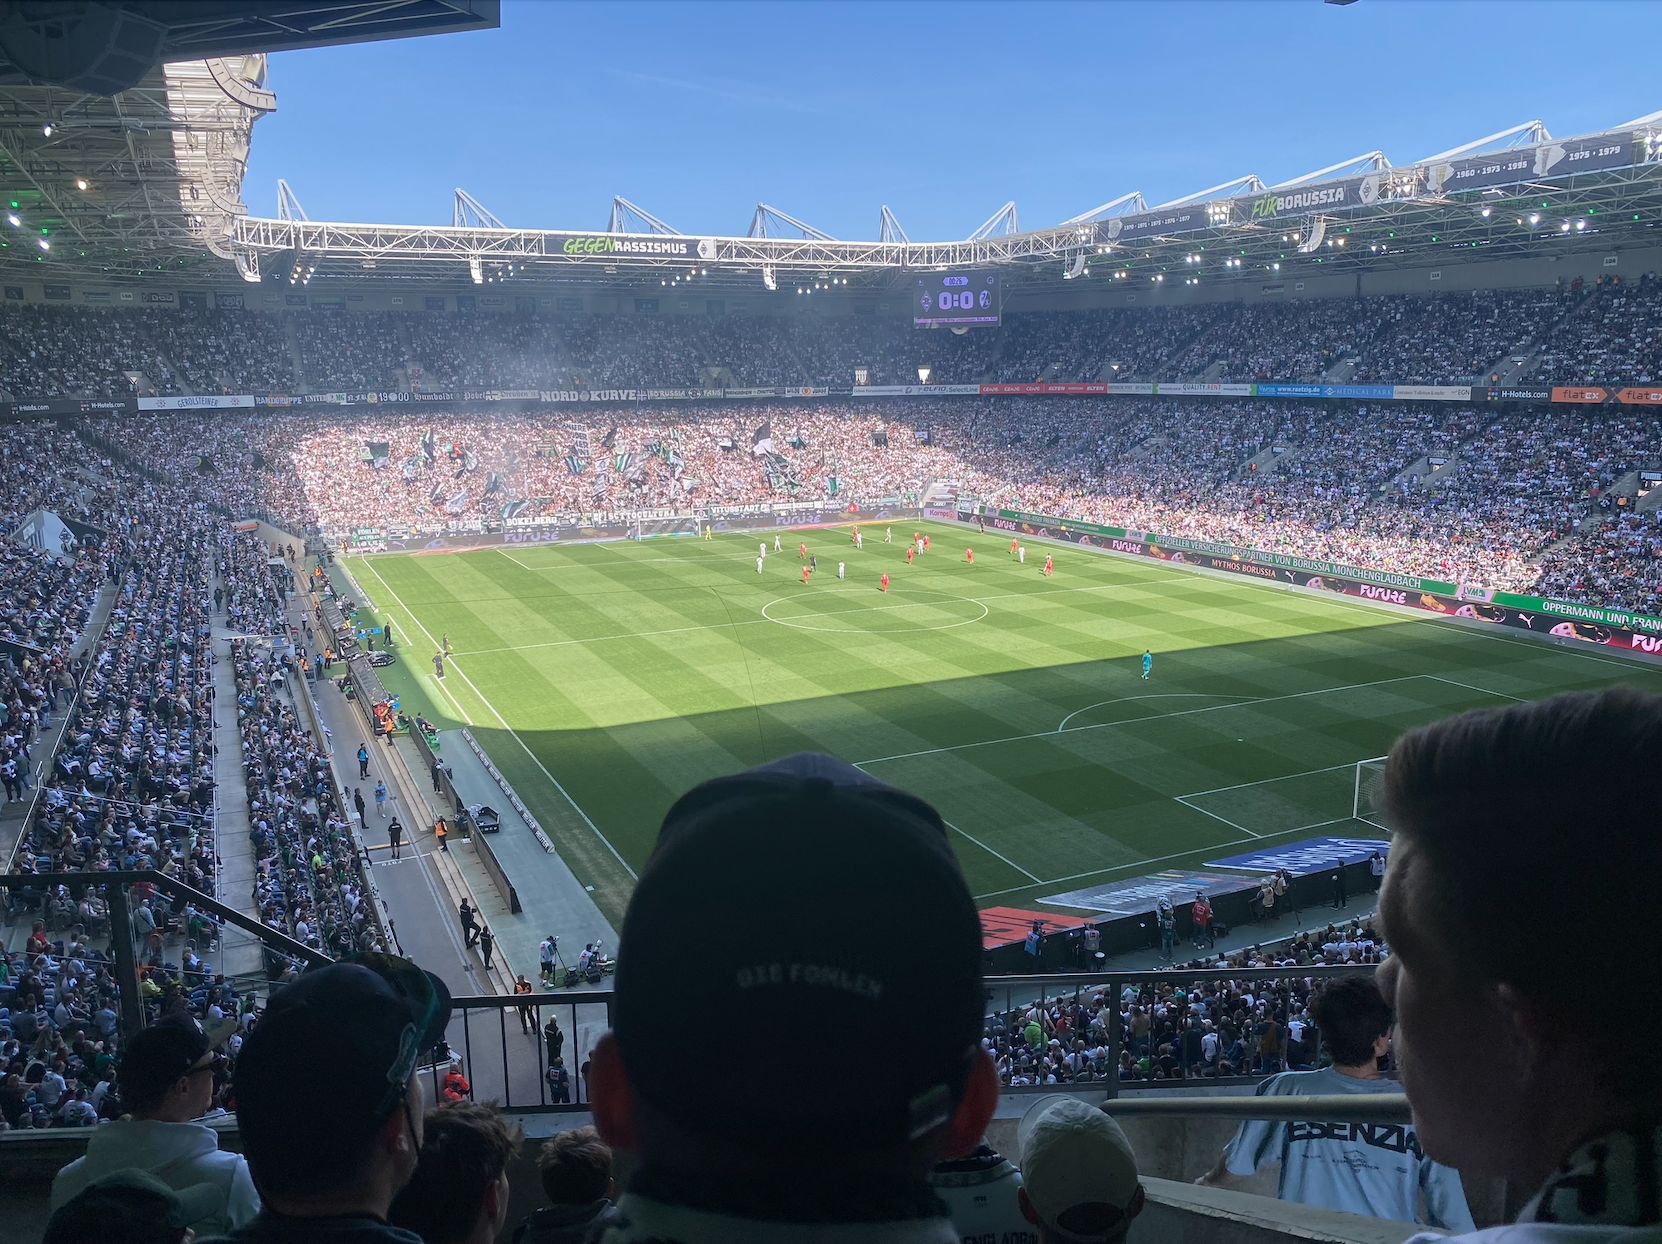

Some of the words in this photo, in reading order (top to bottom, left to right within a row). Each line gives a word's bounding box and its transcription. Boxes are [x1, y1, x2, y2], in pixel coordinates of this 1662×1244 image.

[1598, 145, 1621, 156] 1979
[1455, 169, 1476, 179] 1960
[1482, 165, 1501, 175] 1973
[1252, 194, 1278, 218] FÜR
[1276, 187, 1345, 211] BORUSSIA
[562, 237, 617, 255] GEGEN
[614, 241, 687, 254] RASSISMUS
[938, 290, 975, 310] 0:0
[378, 392, 389, 401] 19
[398, 392, 410, 401] 00
[539, 390, 579, 402] NORD
[589, 389, 637, 401] KURVE
[1501, 390, 1549, 398] H-Hotels.com
[177, 397, 219, 408] GEROLSTEINER
[710, 504, 760, 514] VITUSSTADT
[1154, 535, 1190, 548] OFFIZIELLER
[1190, 539, 1274, 563] VERSICHERUNGSPARTNER
[1274, 556, 1292, 566] VON
[1292, 558, 1331, 573] BORUSSIA
[1211, 558, 1241, 572] MYTHOS
[1241, 563, 1277, 579] BORUSSIA
[1542, 601, 1604, 621] OPPERMANN
[1606, 613, 1630, 625] UND
[736, 962, 783, 988] DIE
